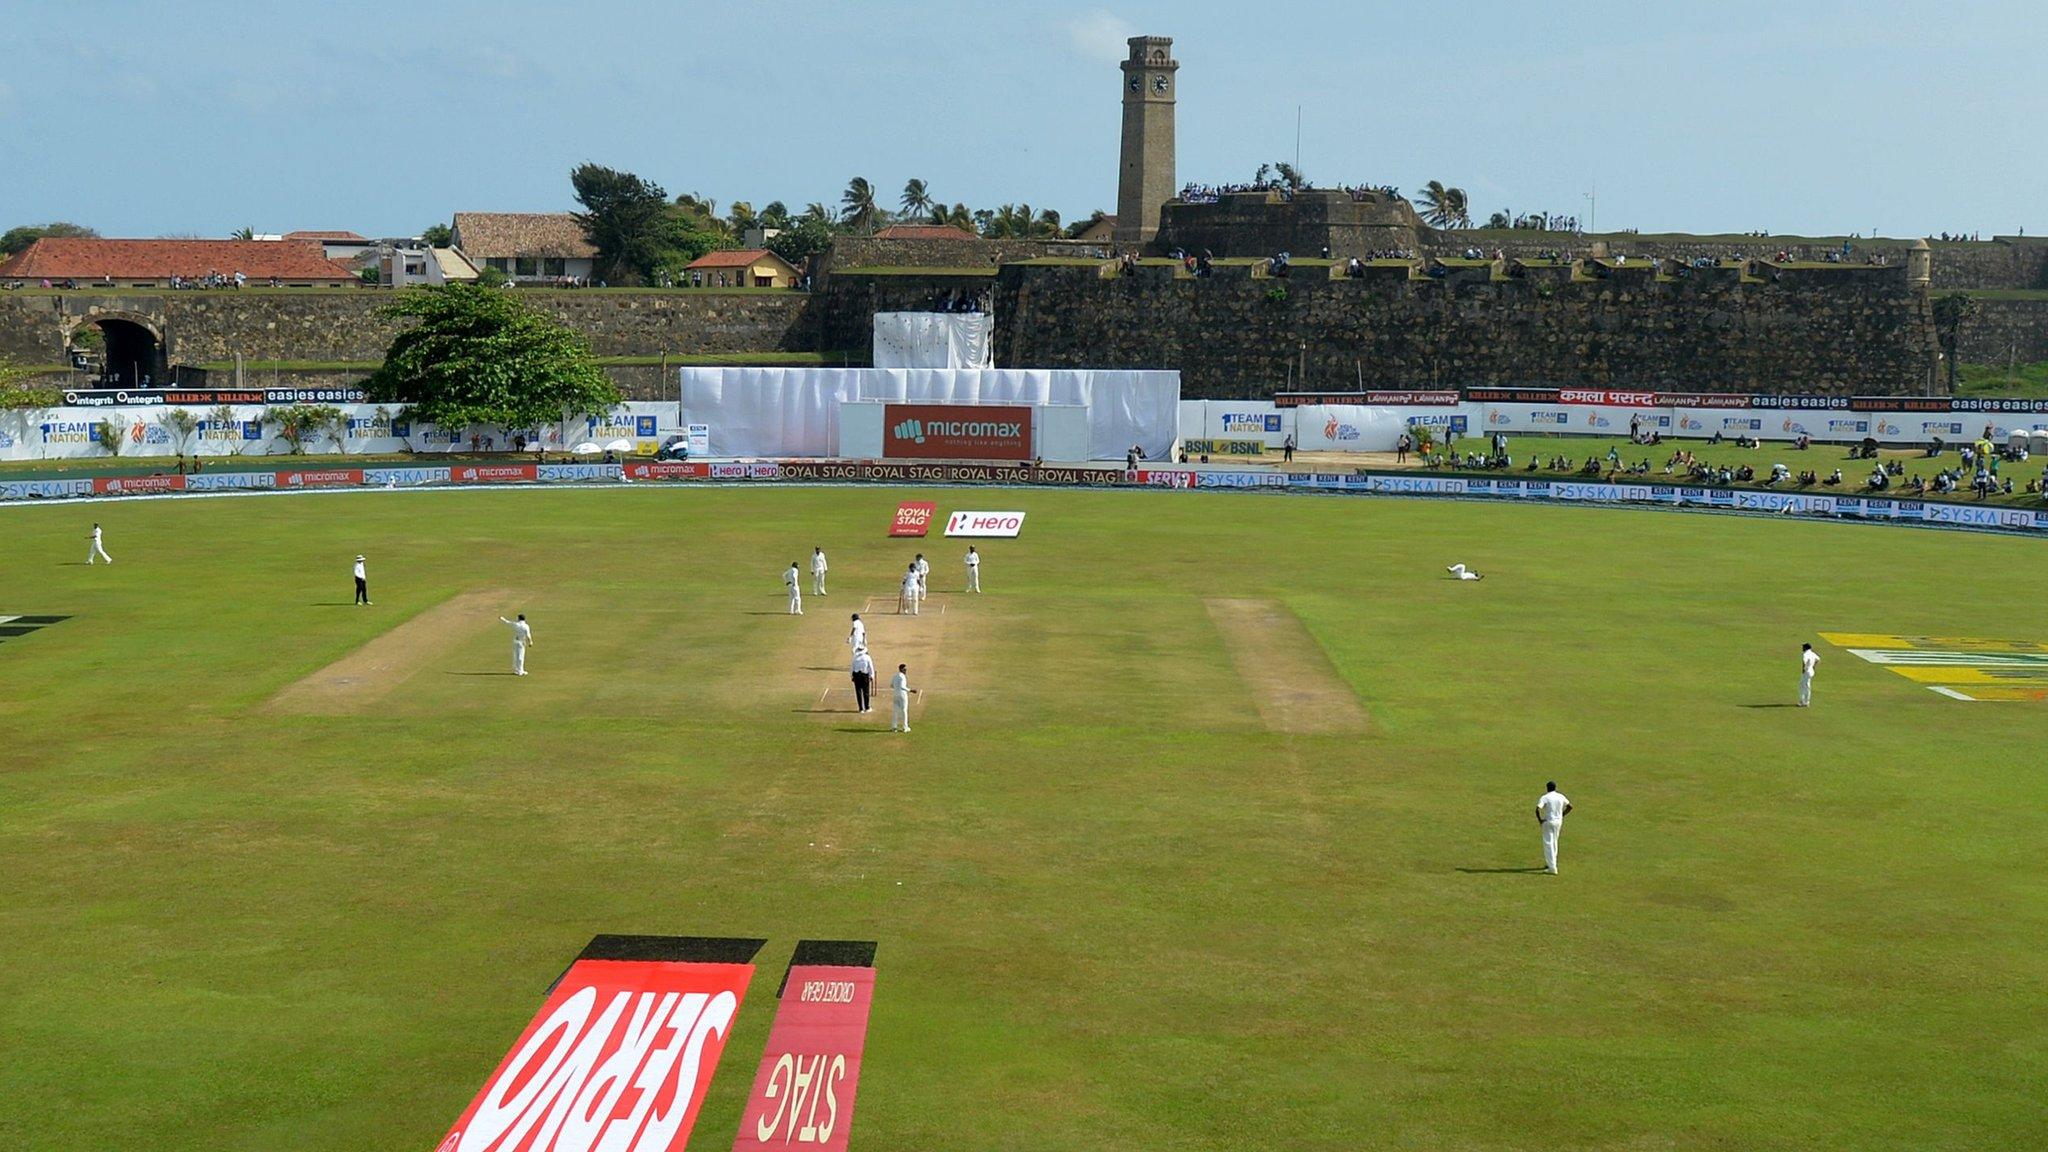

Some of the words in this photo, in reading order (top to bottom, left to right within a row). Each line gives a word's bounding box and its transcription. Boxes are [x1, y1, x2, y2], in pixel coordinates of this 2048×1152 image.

[166, 393, 199, 402] KILLER
[217, 393, 250, 402] KILLER
[267, 389, 315, 400] easies
[317, 389, 364, 400] easies
[1469, 391, 1499, 400] KILLER
[1516, 392, 1547, 400] KILLER
[1560, 390, 1605, 403] कमला
[1609, 392, 1654, 406] पसन्द
[1752, 395, 1799, 406] easies
[1801, 397, 1848, 407] easies
[1853, 400, 1886, 408] KILLER
[1904, 401, 1938, 410] KILLER
[1952, 399, 2000, 409] easies
[356, 418, 390, 428] TEAM
[1232, 413, 1263, 424] TEAM
[1416, 415, 1449, 425] TEAM
[51, 422, 87, 433] TEAM
[205, 420, 241, 430] TEAM
[927, 421, 1021, 437] micromax
[1230, 424, 1264, 433] NATION
[50, 433, 87, 443] NATION
[205, 431, 241, 440] NATION
[356, 429, 390, 438] NATION
[595, 427, 635, 438] NATION
[990, 440, 1022, 448] anything
[1185, 440, 1216, 453] BSNL
[1230, 442, 1263, 455] BSNL
[426, 469, 450, 480] LED
[479, 467, 523, 476] micromax
[599, 466, 622, 478] LED
[650, 466, 695, 474] micromax
[719, 466, 742, 475] Hero
[754, 466, 777, 475] Hero
[778, 466, 818, 477] ROYAL
[822, 466, 856, 477] STAG
[864, 466, 905, 478] ROYAL
[909, 467, 943, 478] STAG
[951, 467, 991, 479] ROYAL
[996, 468, 1029, 480] STAG
[250, 475, 276, 487] LED
[304, 472, 350, 481] micromax
[1037, 469, 1079, 482] ROYAL
[1082, 470, 1117, 483] STAG
[1259, 475, 1284, 487] LED
[67, 481, 93, 495] LED
[124, 479, 171, 487] micromax
[1437, 481, 1463, 493] LED
[1621, 487, 1647, 499] LED
[1804, 498, 1831, 512] LED
[897, 507, 931, 517] ROYAL
[897, 516, 925, 525] STAG
[972, 517, 1019, 529] Hero
[2000, 512, 2030, 527] LED
[800, 981, 822, 1002] GEAR
[823, 981, 855, 1003] CRICKET
[456, 985, 738, 1152] SERVO
[757, 1052, 846, 1146] STAG
